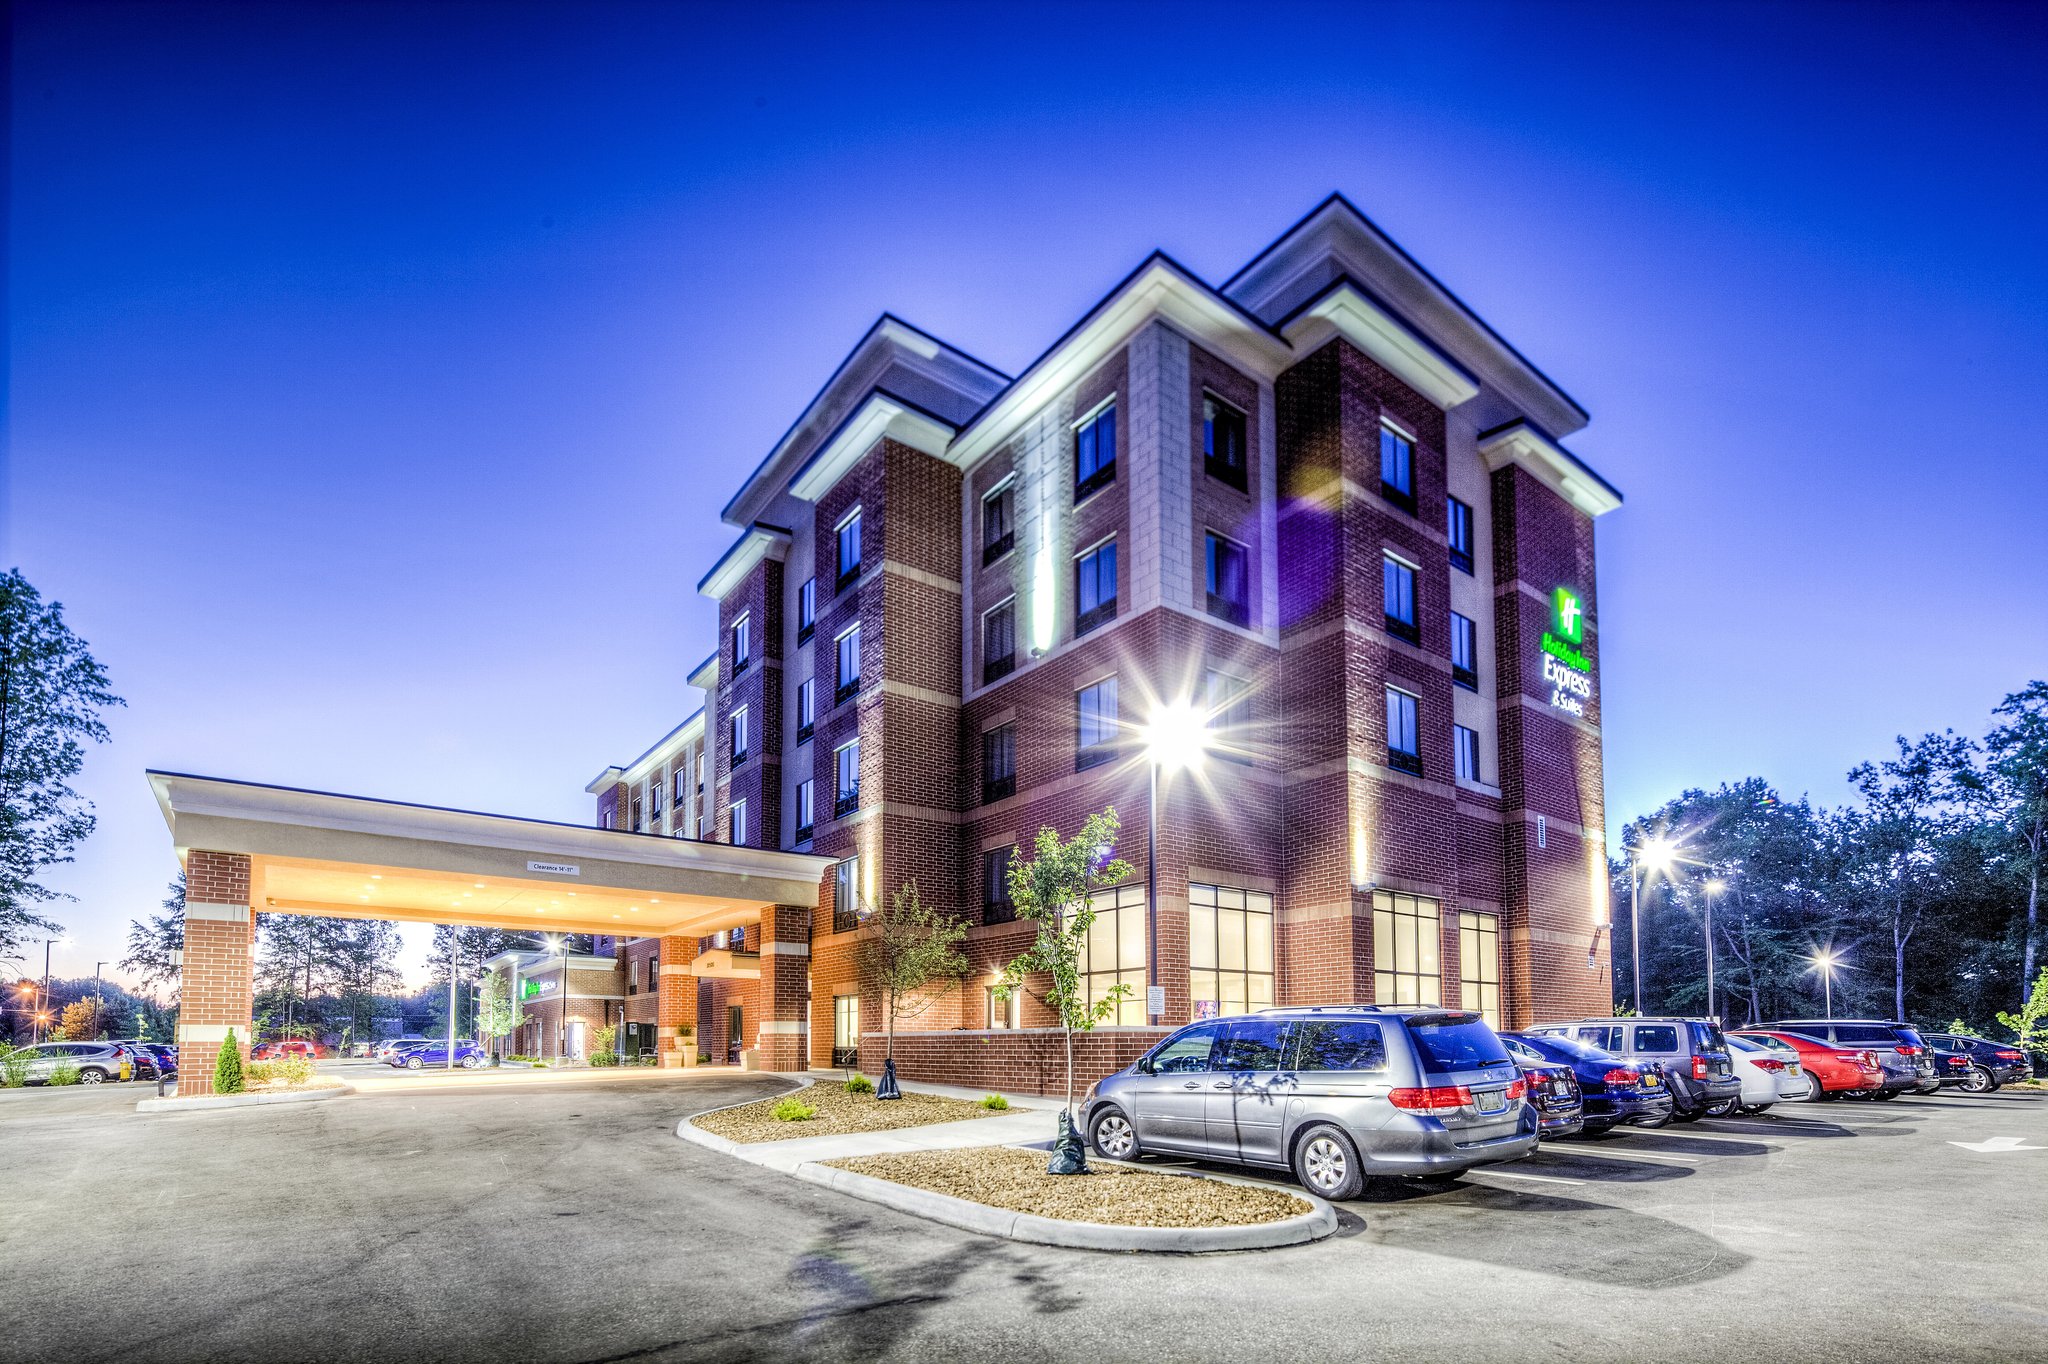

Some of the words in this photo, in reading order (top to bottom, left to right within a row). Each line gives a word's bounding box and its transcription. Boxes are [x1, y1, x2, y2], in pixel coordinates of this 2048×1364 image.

[1542, 632, 1576, 669] Holiday
[1575, 650, 1590, 672] Inn
[1544, 653, 1590, 698] Express
[1552, 690, 1560, 706] &
[1560, 693, 1583, 716] Suites
[533, 863, 558, 872] Clearance
